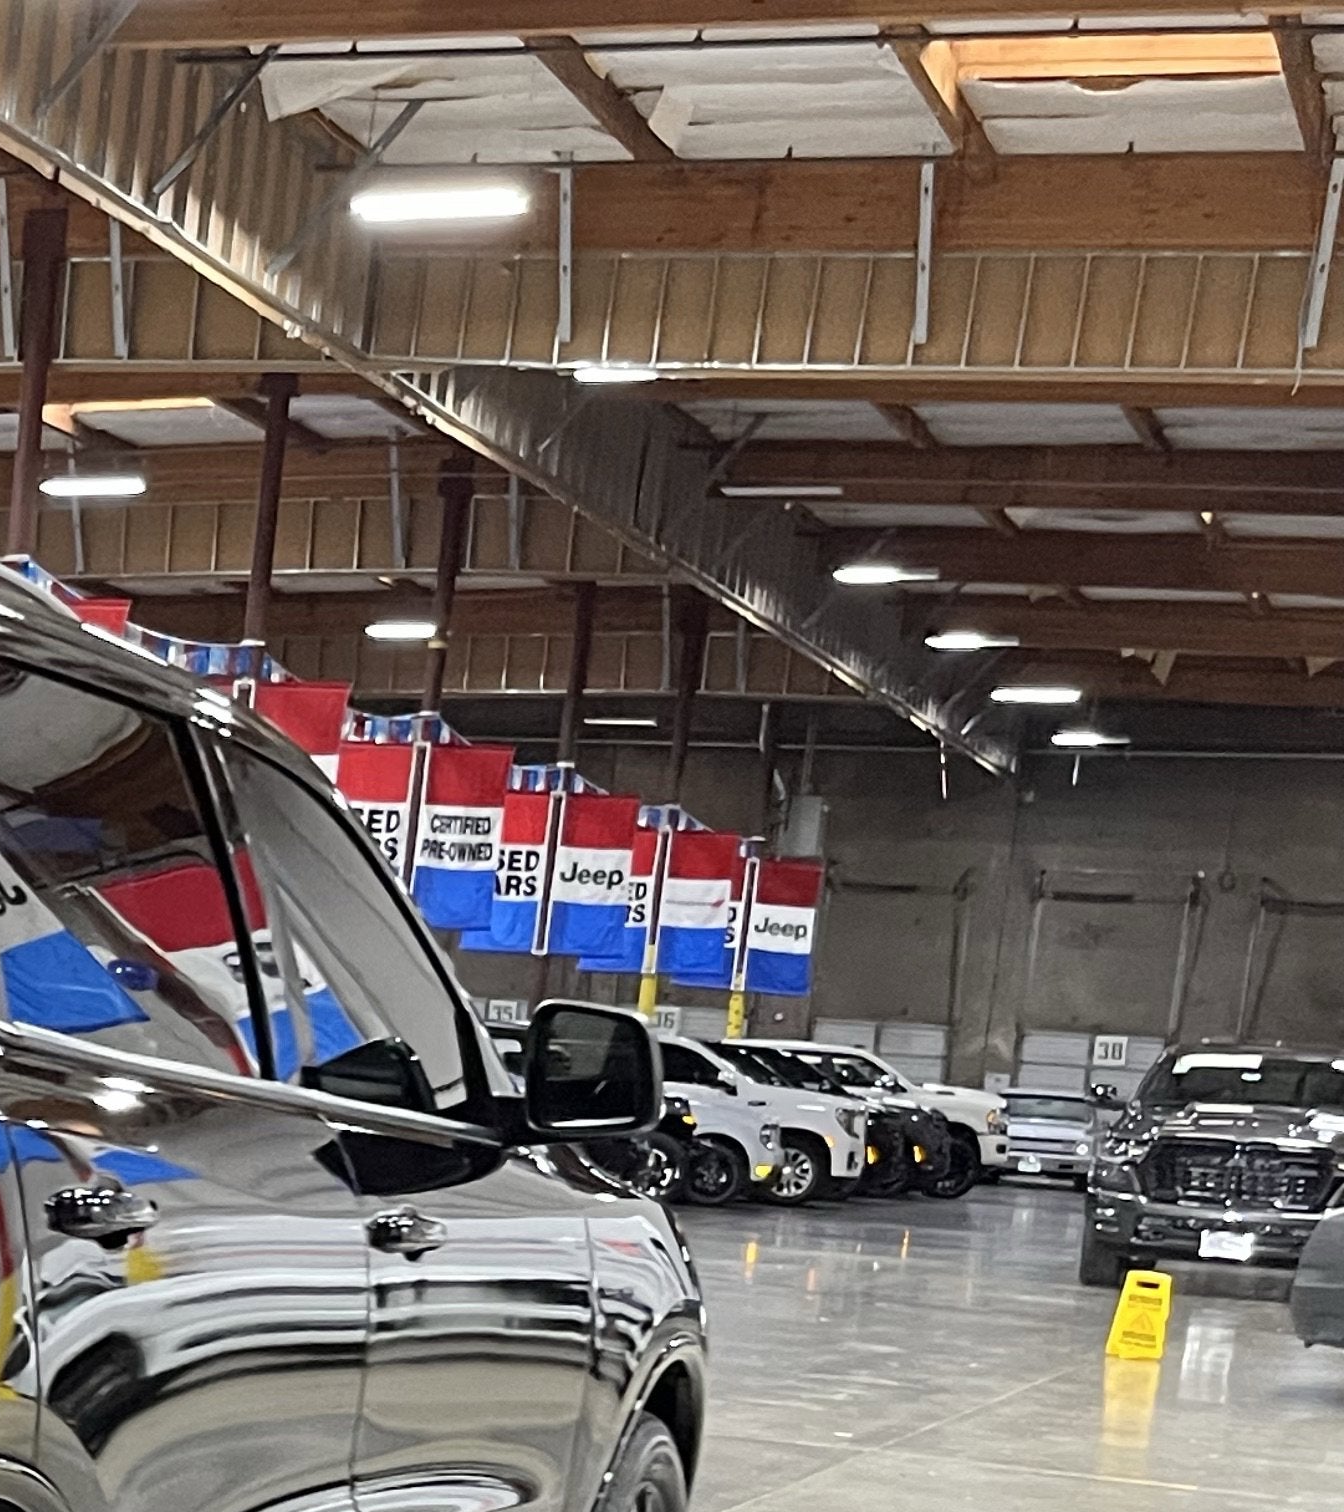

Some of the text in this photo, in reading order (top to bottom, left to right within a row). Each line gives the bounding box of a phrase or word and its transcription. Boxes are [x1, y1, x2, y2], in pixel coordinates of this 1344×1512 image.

[430, 814, 491, 835] CERTIFIED
[420, 840, 493, 862] PRE-OWNED
[560, 862, 624, 890] Jeep
[754, 917, 807, 941] Jeep
